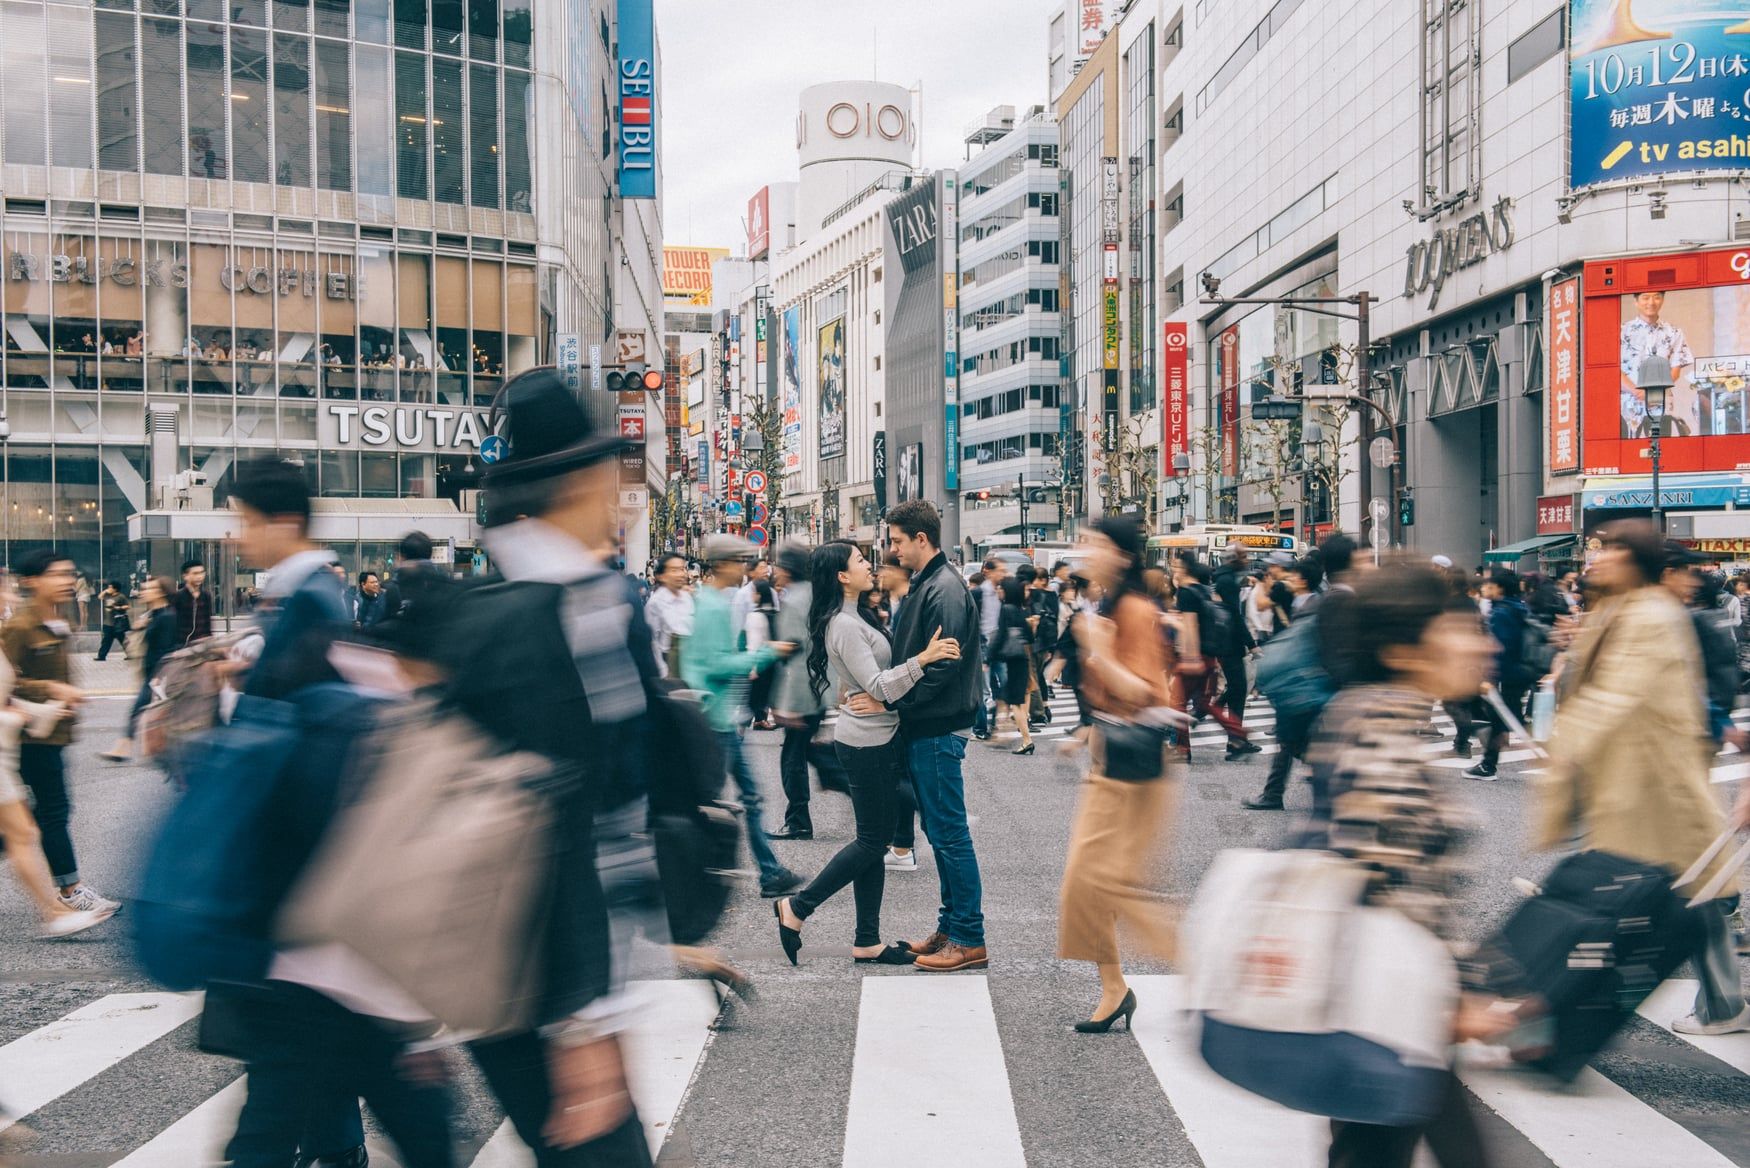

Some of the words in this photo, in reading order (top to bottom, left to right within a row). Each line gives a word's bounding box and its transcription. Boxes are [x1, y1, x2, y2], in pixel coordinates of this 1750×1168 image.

[622, 59, 651, 171] SEIBU
[1640, 142, 1669, 163] tv
[1678, 135, 1750, 159] asahi
[893, 200, 936, 254] ZARA
[664, 250, 710, 270] TOWER
[663, 271, 712, 290] ECORD
[1553, 285, 1574, 308] 名物
[567, 338, 578, 387] 渋谷駅前
[712, 333, 721, 394] KARAOKE
[1556, 310, 1571, 463] 天津甘栗
[329, 405, 513, 447] TSUTAY
[623, 420, 641, 437] 本
[1171, 367, 1183, 466] 三菱東京UFJ銀
[875, 438, 885, 477] ZARA
[1540, 505, 1572, 524] 天津甘栗
[1609, 492, 1693, 505] SANZNRI
[1703, 540, 1740, 551] TAX
